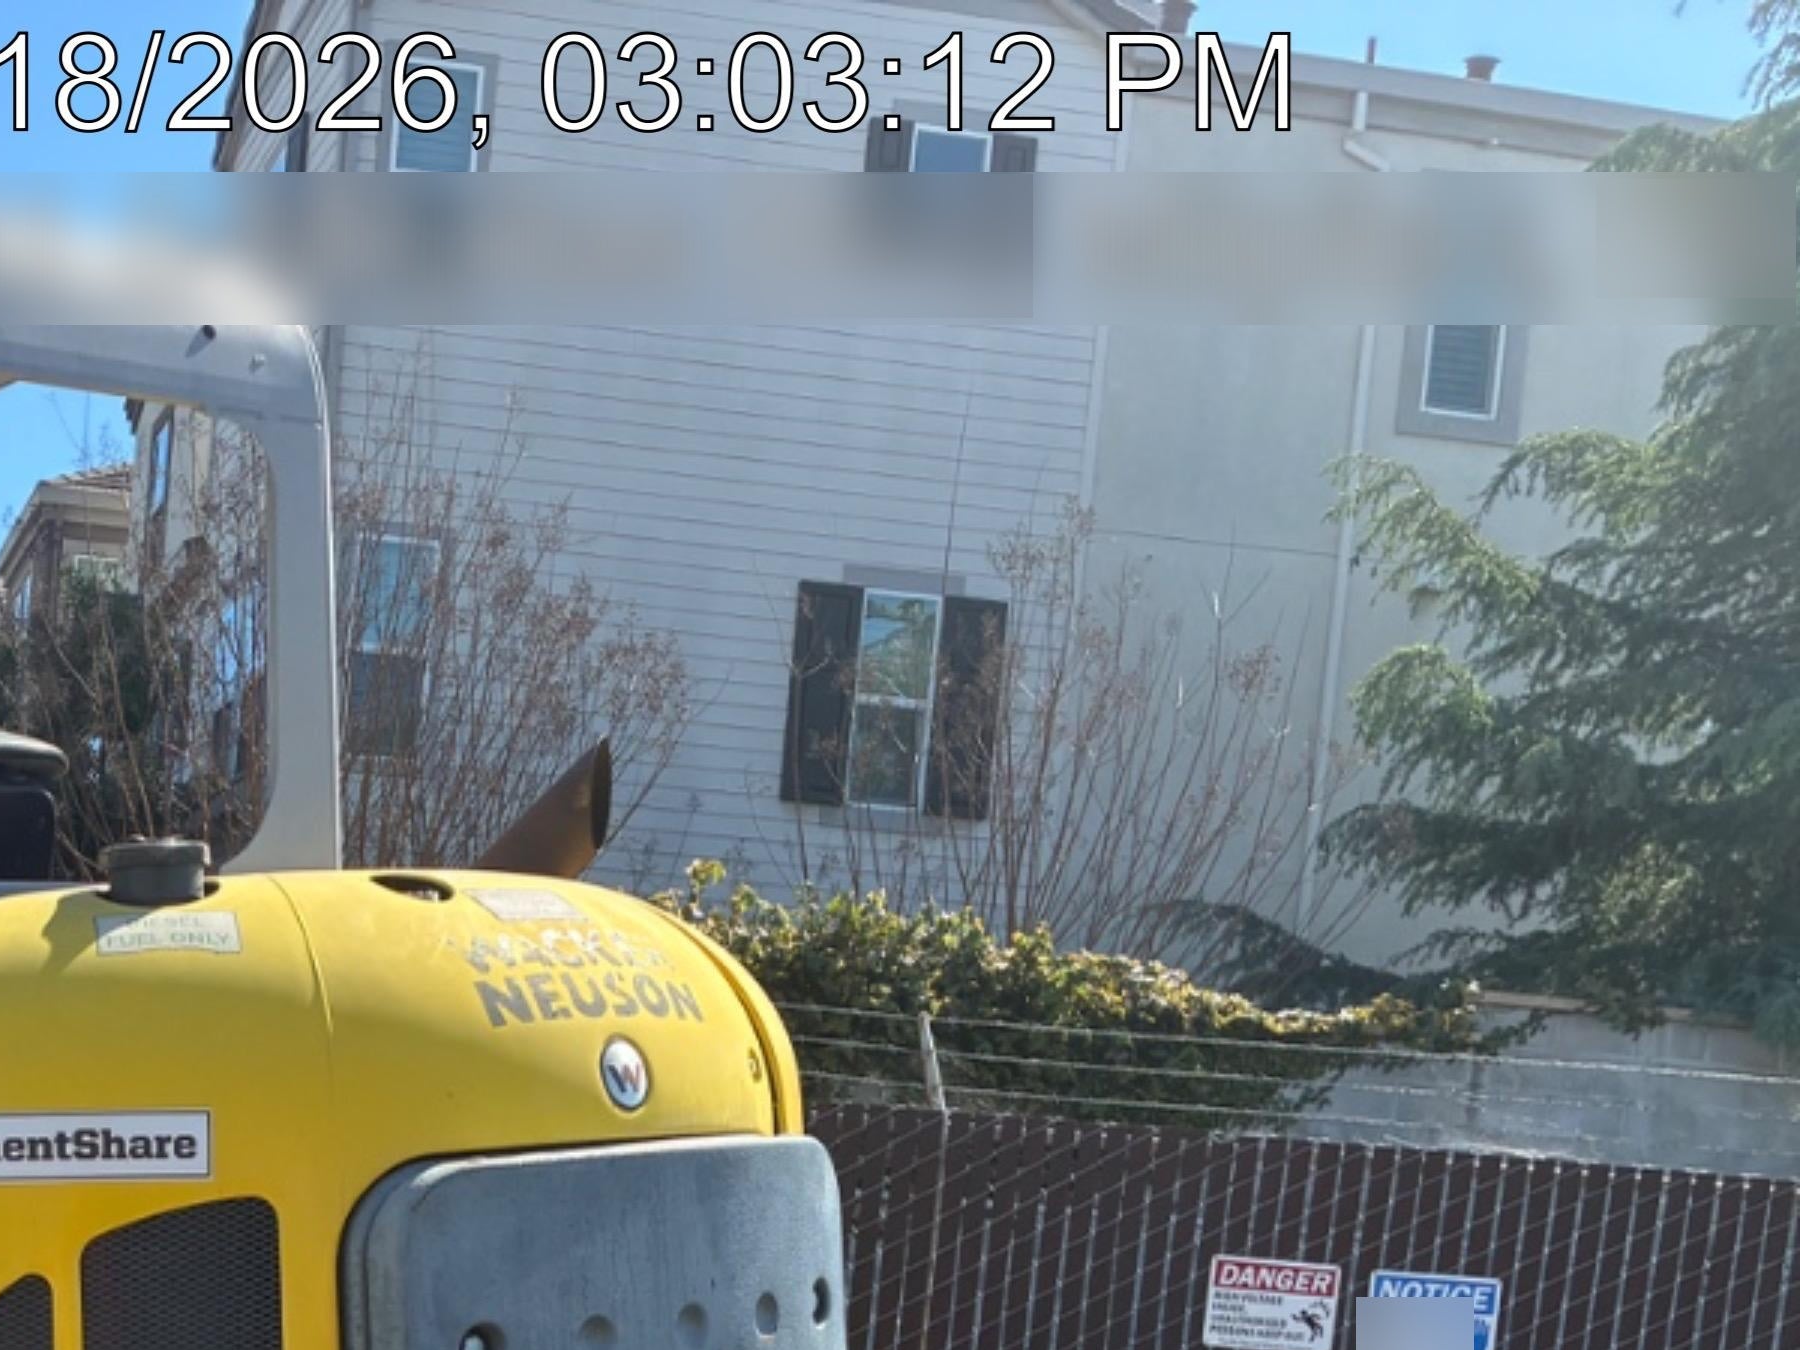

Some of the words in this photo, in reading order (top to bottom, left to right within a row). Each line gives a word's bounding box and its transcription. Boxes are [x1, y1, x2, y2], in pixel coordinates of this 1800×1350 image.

[170, 931, 229, 946] ONLY
[465, 929, 674, 973] WACK
[474, 972, 704, 1028] NEUSON
[1220, 1263, 1334, 1295] DANGER
[1379, 1279, 1493, 1312] NOTICE
